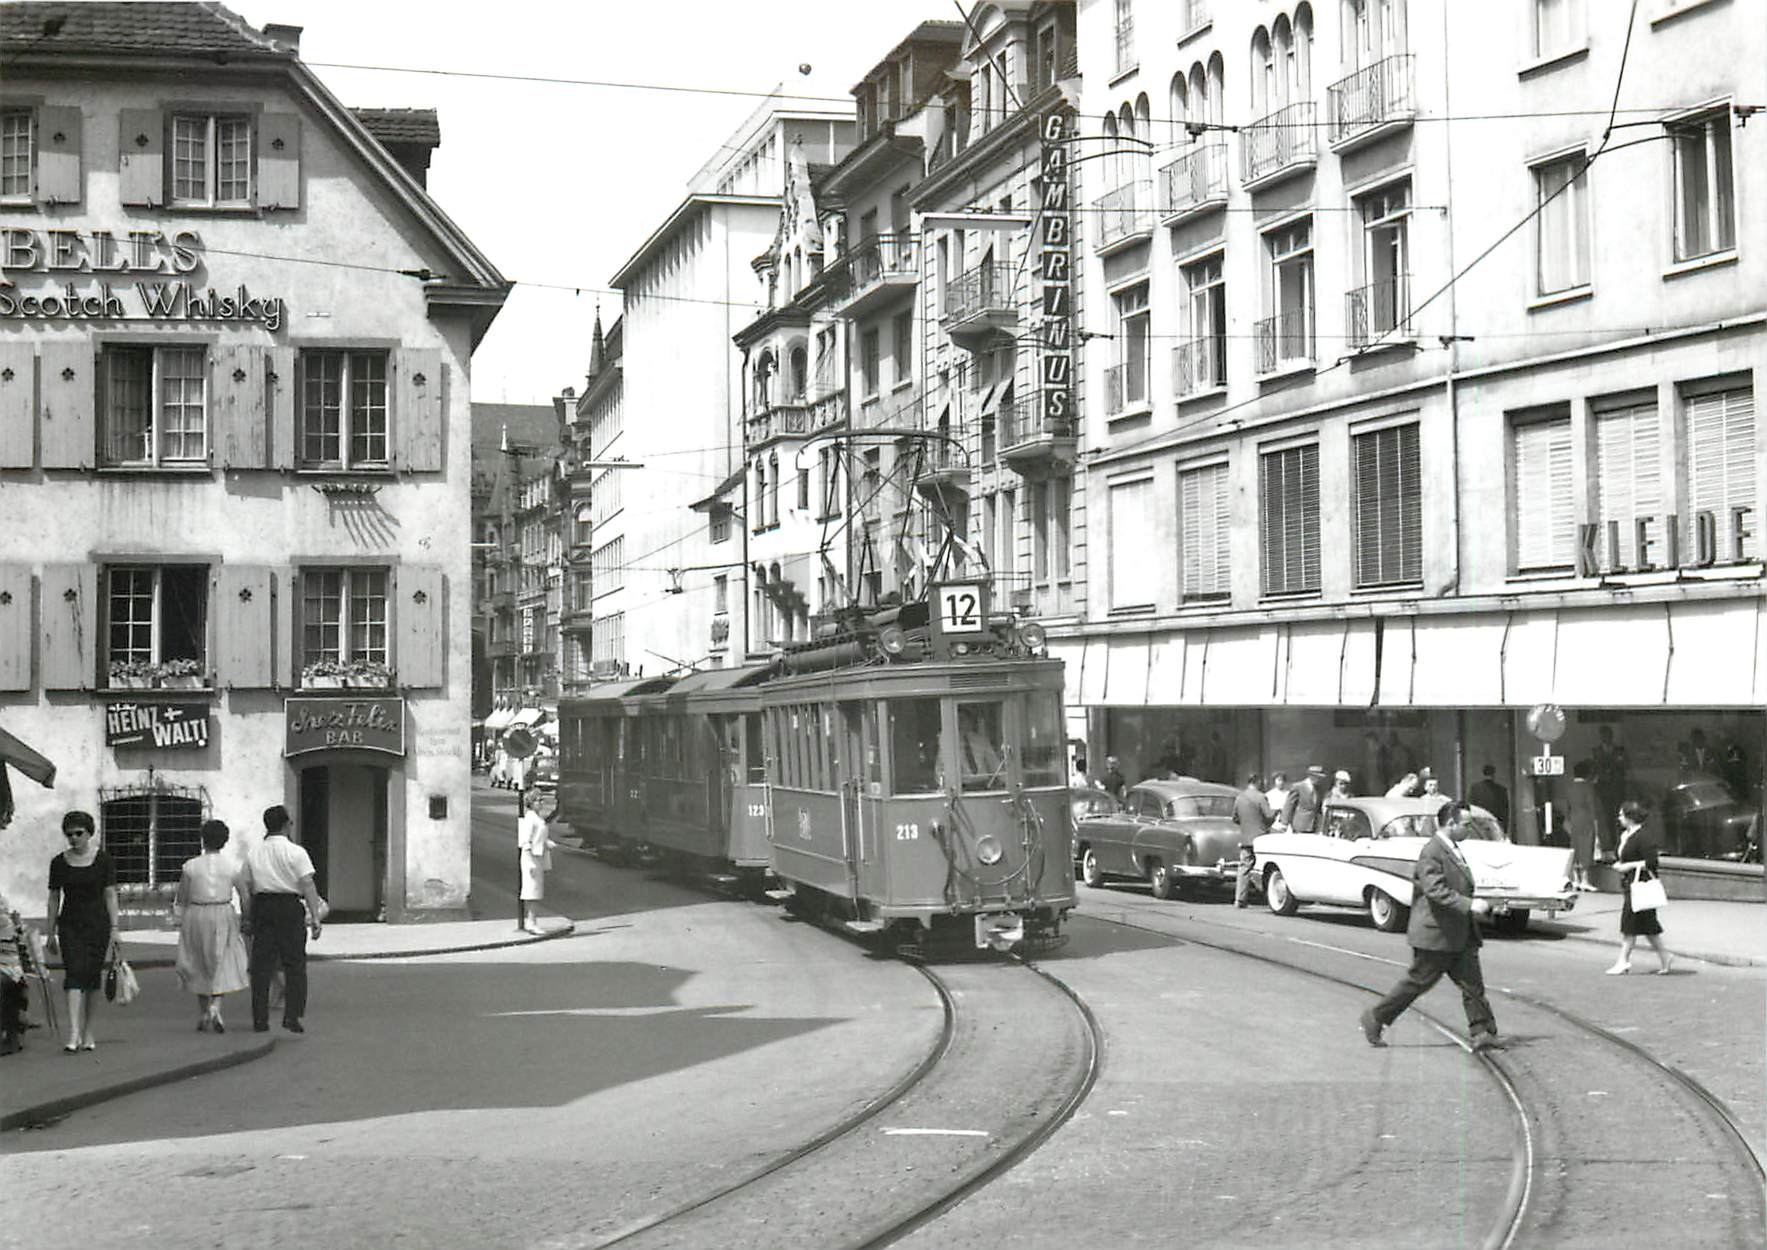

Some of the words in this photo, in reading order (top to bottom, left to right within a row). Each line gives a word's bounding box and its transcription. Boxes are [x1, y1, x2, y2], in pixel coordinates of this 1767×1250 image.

[1, 229, 198, 271] BELL'S
[1044, 115, 1067, 416] GAMBRINUS
[0, 282, 123, 316] Scotch
[136, 282, 282, 330] Whisky
[946, 593, 977, 626] 12
[152, 718, 208, 747] WALT!
[748, 804, 765, 817] 123
[896, 824, 919, 840] 213
